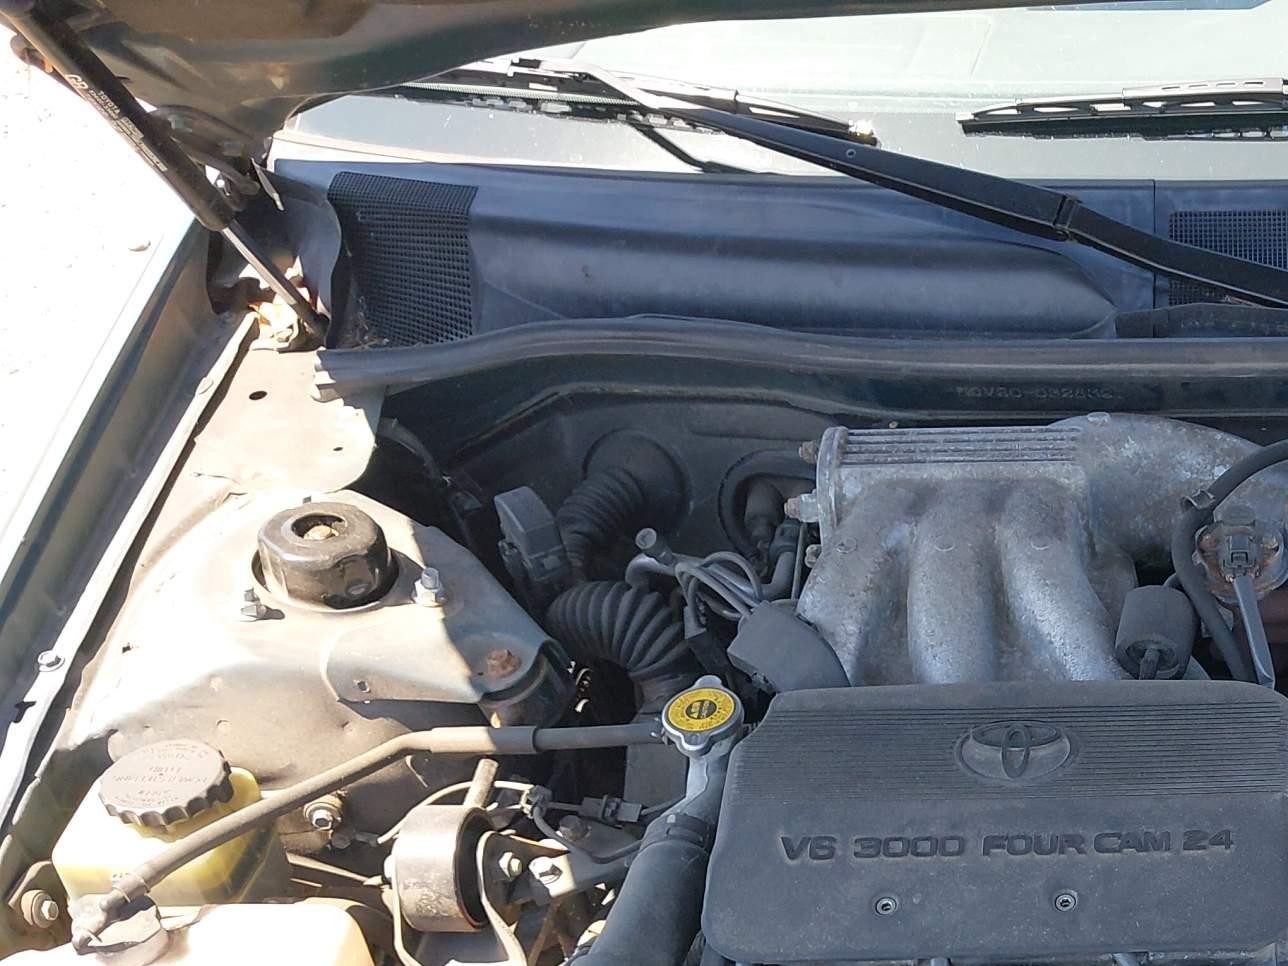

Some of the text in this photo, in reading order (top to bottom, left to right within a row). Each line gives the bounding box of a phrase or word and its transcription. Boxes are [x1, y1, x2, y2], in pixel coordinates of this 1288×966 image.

[97, 90, 121, 115] TOYOTA
[781, 829, 1236, 861] V6 3000 FOUR CAM 24
